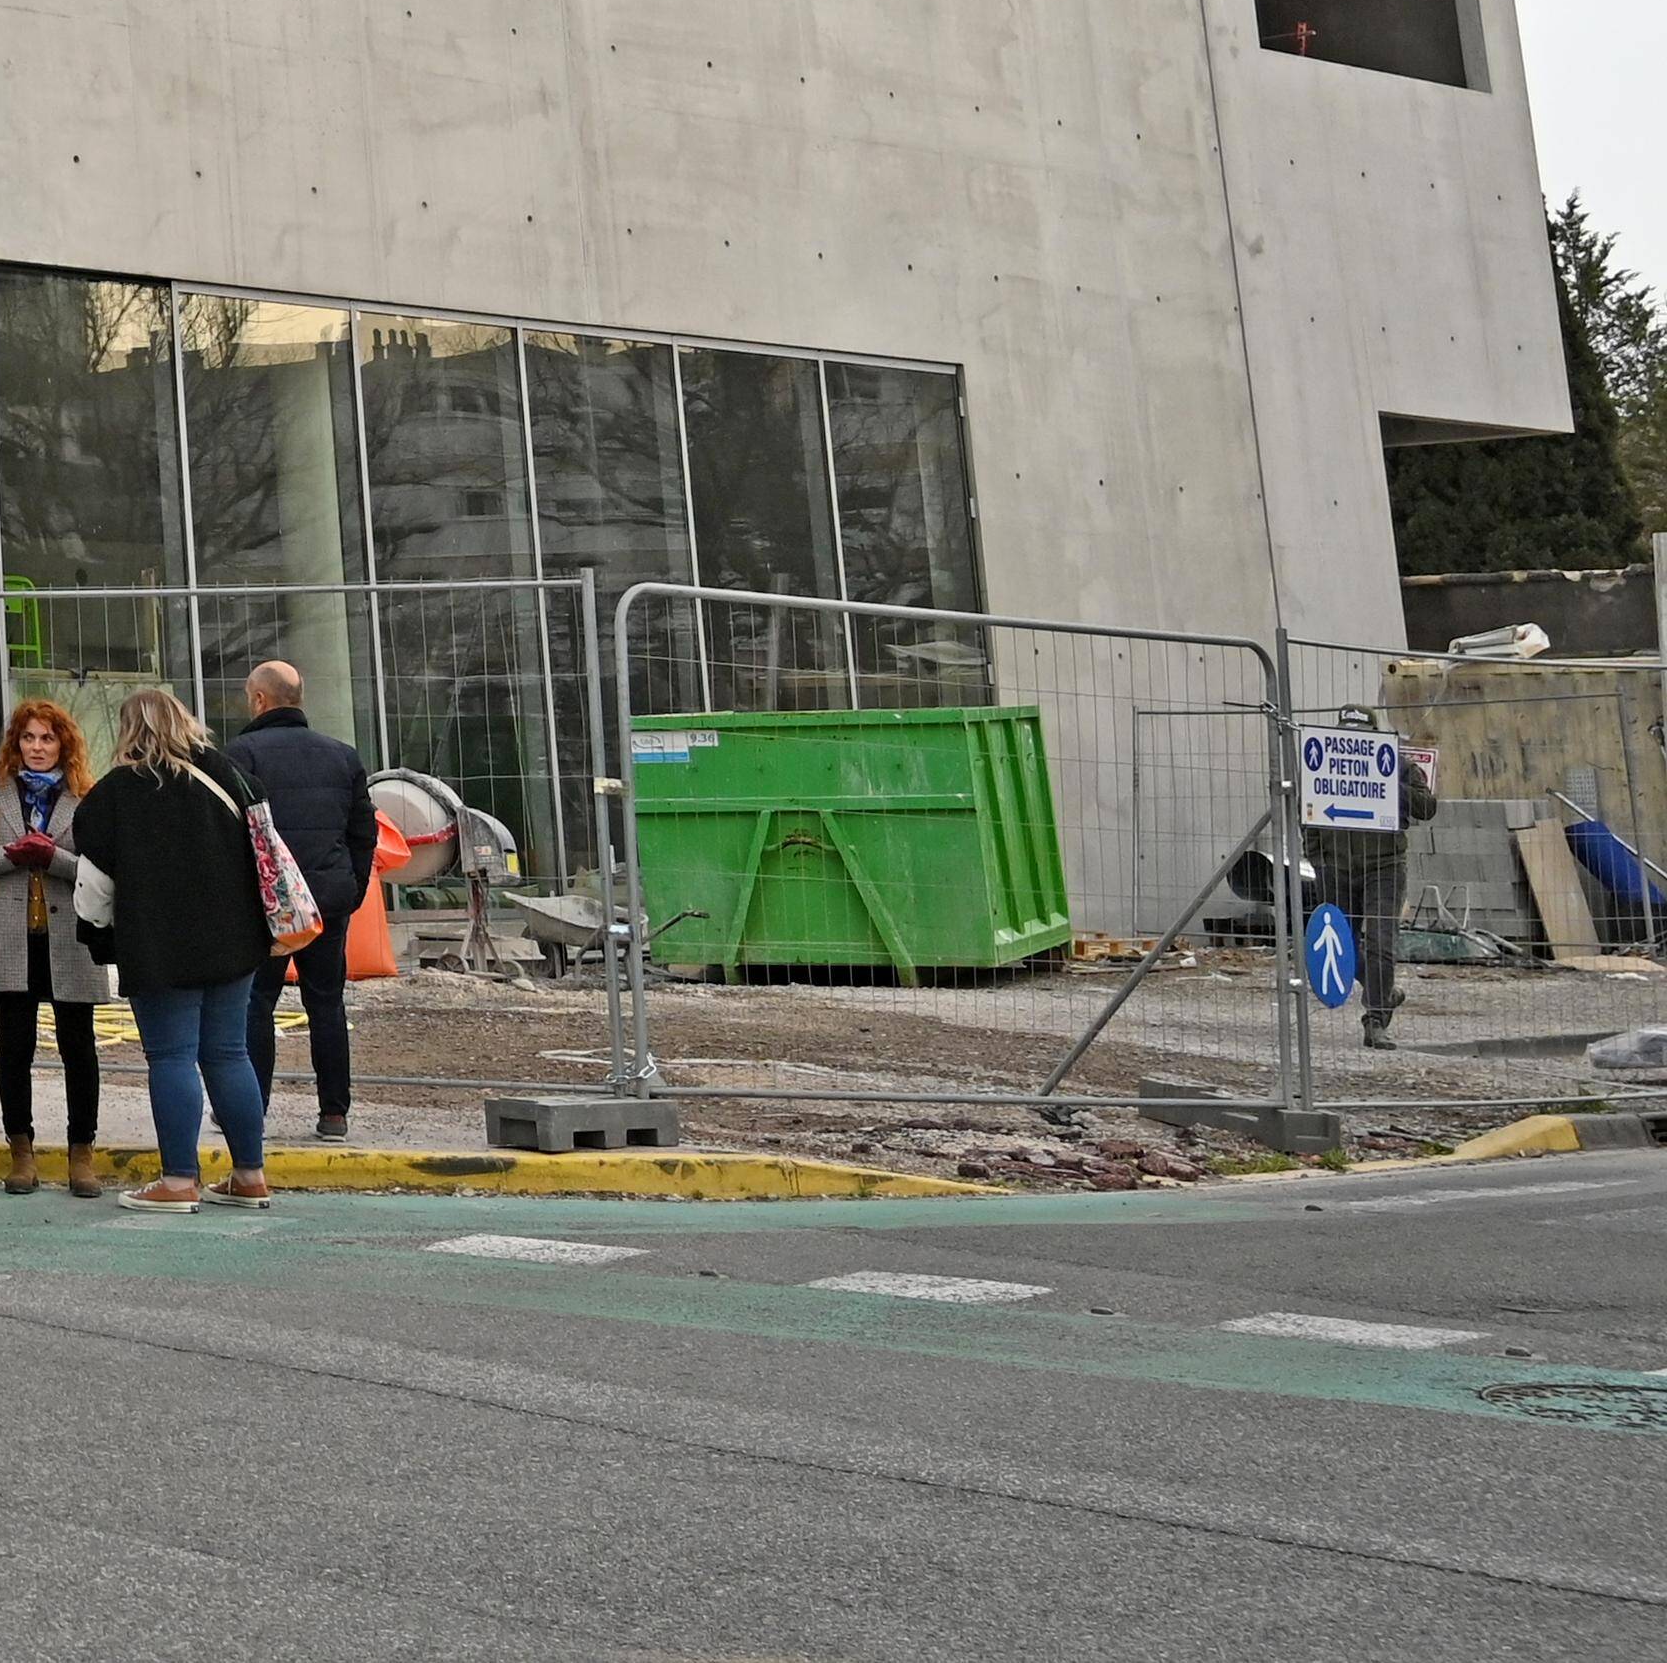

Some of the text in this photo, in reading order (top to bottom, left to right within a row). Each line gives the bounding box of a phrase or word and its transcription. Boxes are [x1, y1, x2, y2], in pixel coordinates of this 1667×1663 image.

[1325, 736, 1375, 757] PASSAGE
[1329, 757, 1369, 777] PIETON
[1313, 777, 1386, 800] OBLIGATOIRE
